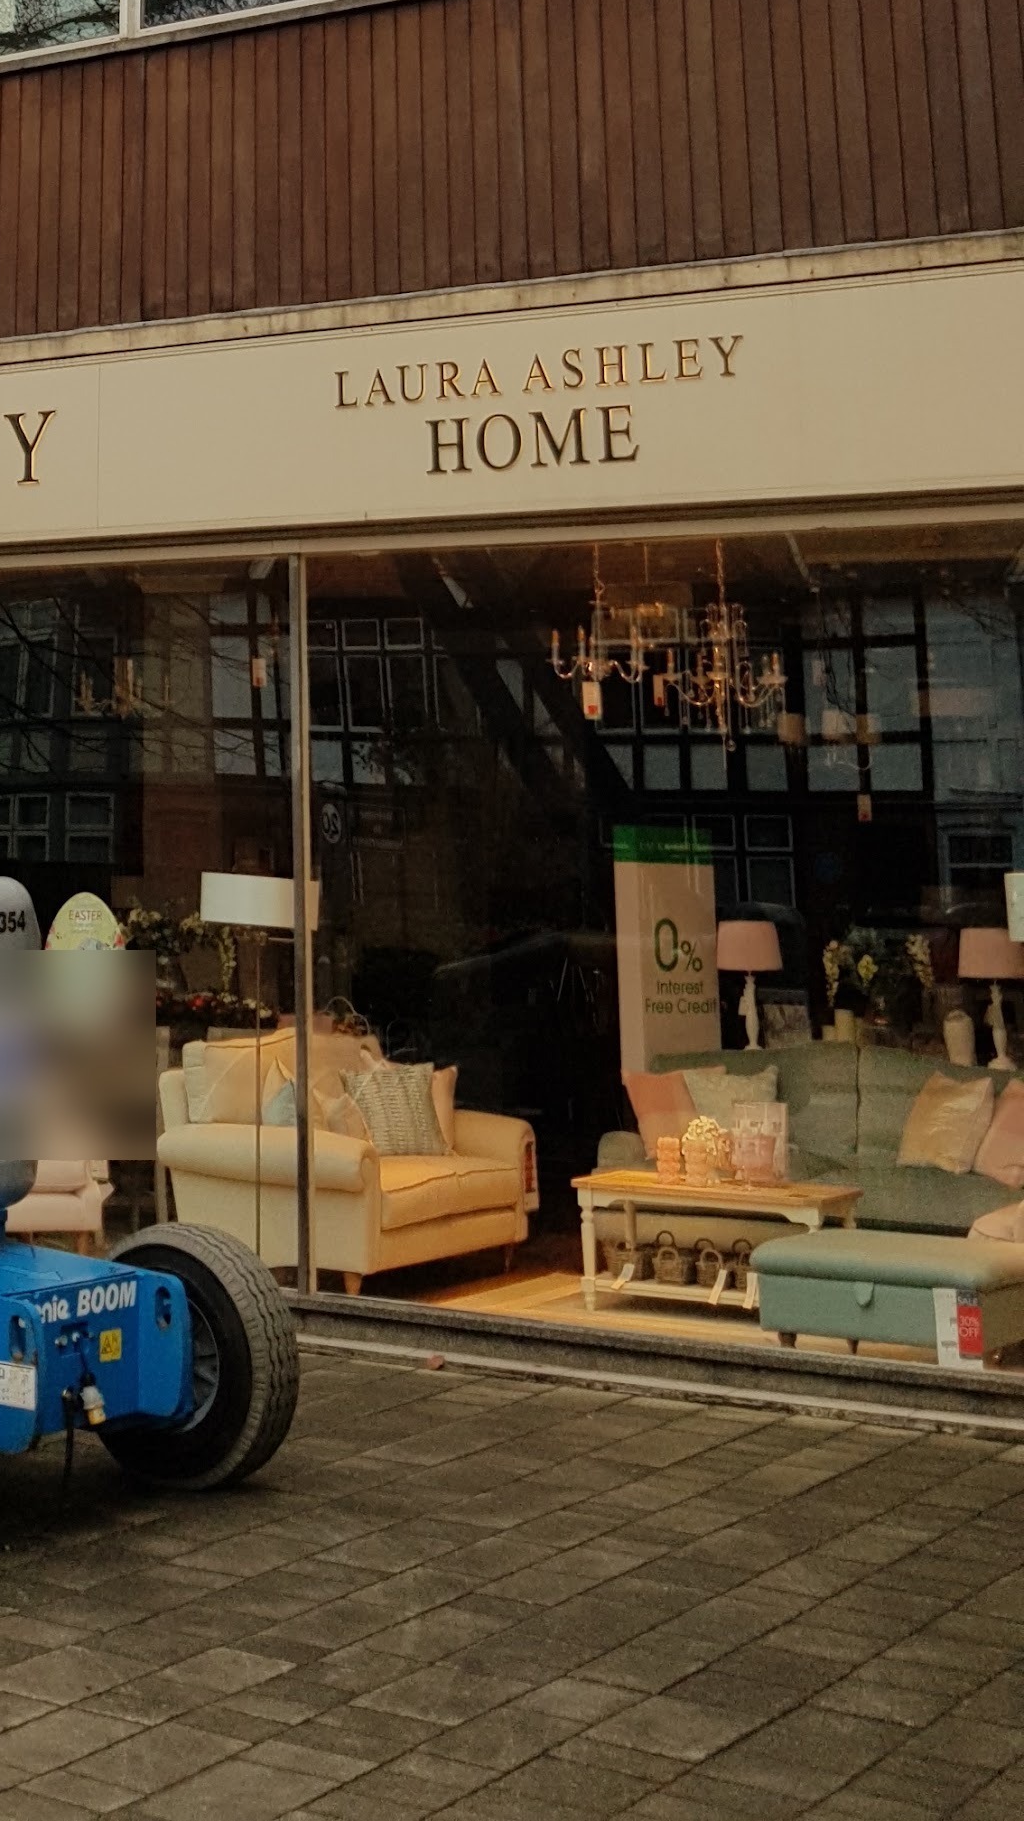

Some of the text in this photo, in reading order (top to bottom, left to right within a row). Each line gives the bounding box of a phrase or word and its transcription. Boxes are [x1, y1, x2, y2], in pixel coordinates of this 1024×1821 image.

[335, 335, 745, 409] LAURA ASHLEY
[426, 404, 640, 475] HOME
[69, 910, 102, 922] EASTER
[654, 917, 703, 972] 0%
[657, 980, 704, 995] Interest
[645, 998, 717, 1015] Free Credit
[77, 1281, 137, 1317] BOOM
[959, 1327, 979, 1338] OFF
